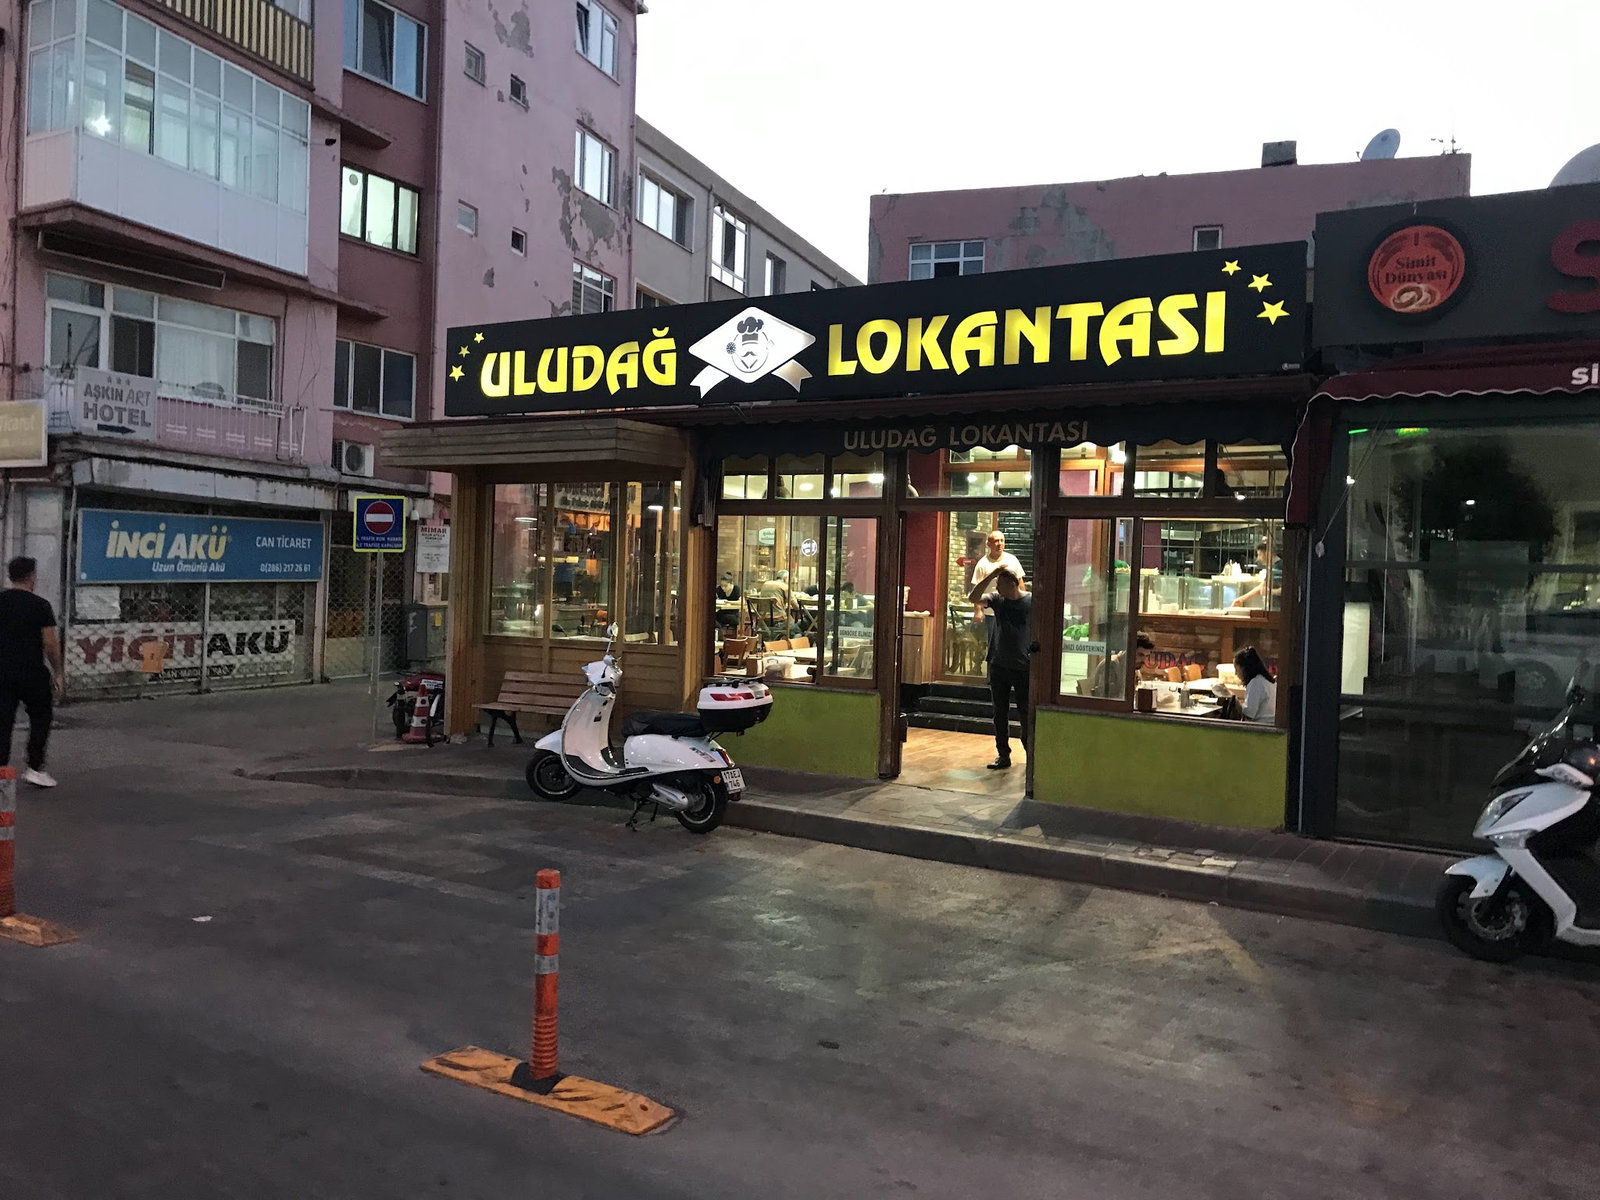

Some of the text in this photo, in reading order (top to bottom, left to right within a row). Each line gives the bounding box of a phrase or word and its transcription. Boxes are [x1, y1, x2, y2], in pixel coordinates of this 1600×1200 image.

[1396, 255, 1436, 269] Simit
[480, 290, 1226, 398] ULUDAĞ LOKANTASI
[83, 382, 152, 407] AŞKIN ART
[83, 402, 152, 427] HOTEL
[843, 420, 1089, 451] ULUDAĞ LOKANTASI
[105, 519, 228, 560] İNCİ AKÜ
[256, 534, 312, 549] CAN TİCARET
[152, 560, 226, 573] Uzun Ömürlü Akü
[207, 625, 290, 658] AKÜ
